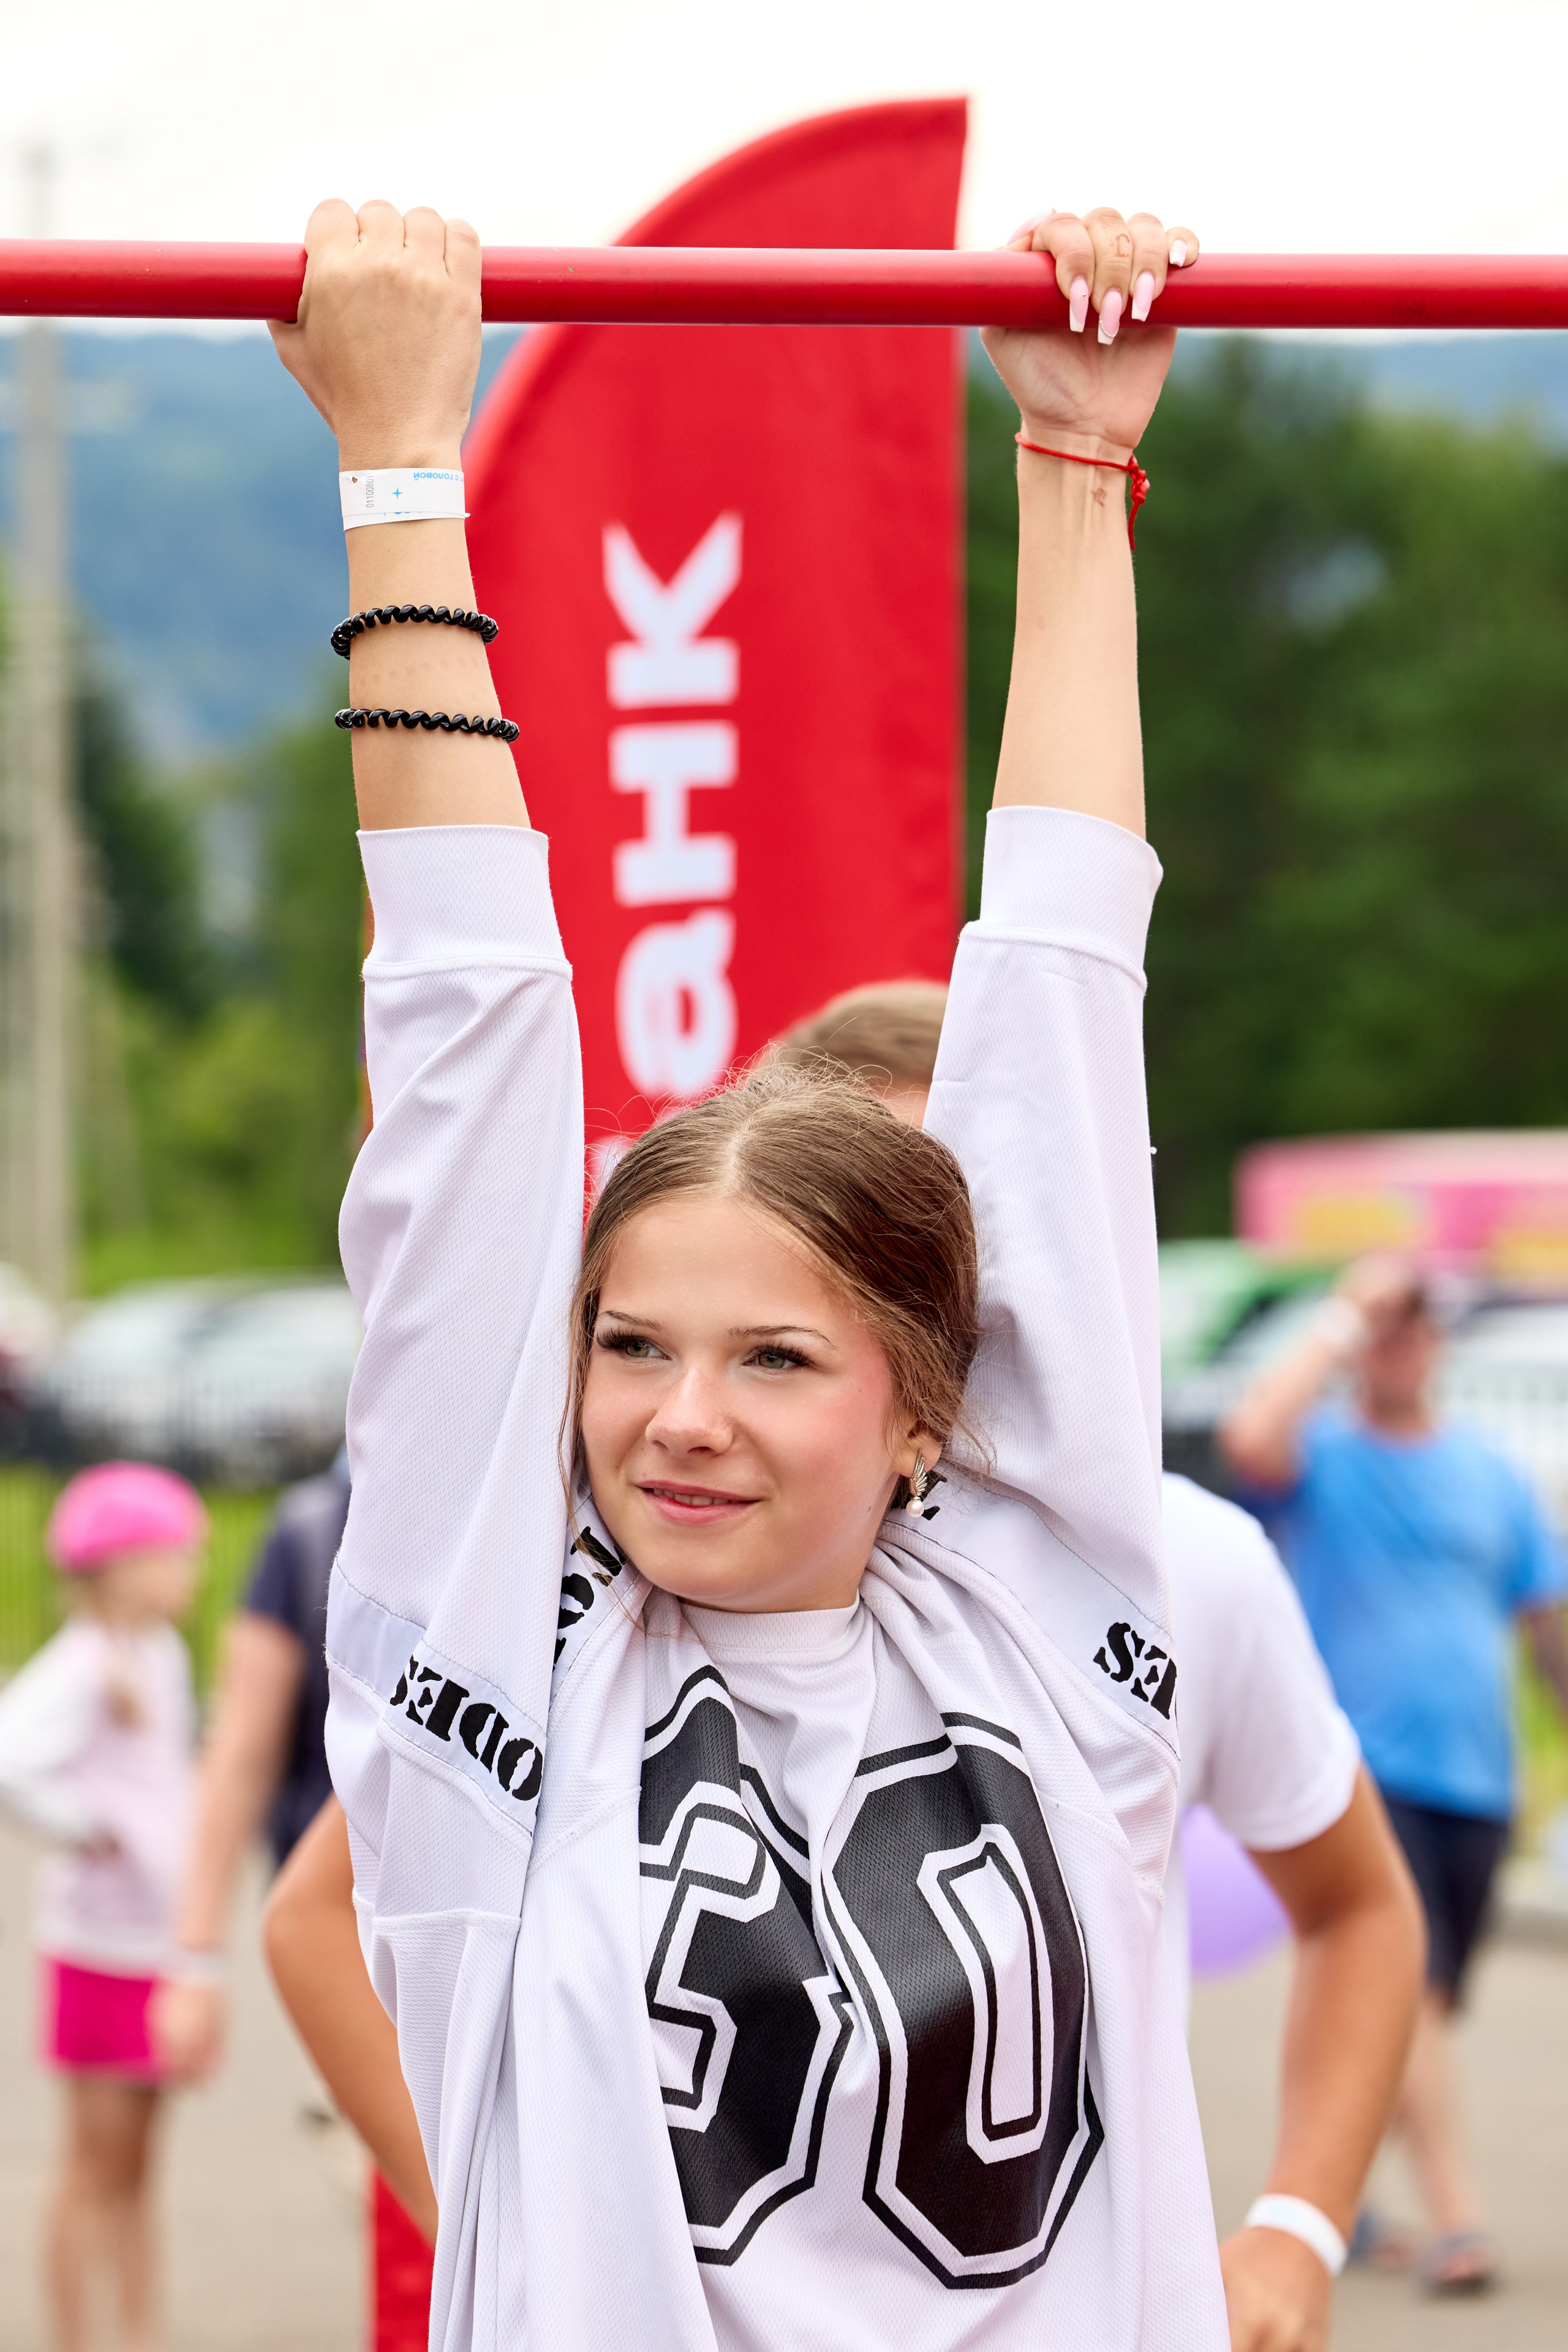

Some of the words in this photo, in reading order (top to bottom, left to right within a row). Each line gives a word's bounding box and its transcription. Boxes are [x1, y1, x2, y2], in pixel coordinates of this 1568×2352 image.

[366, 475, 374, 508] 01100801
[413, 472, 453, 481] головой
[594, 508, 743, 1191] анк
